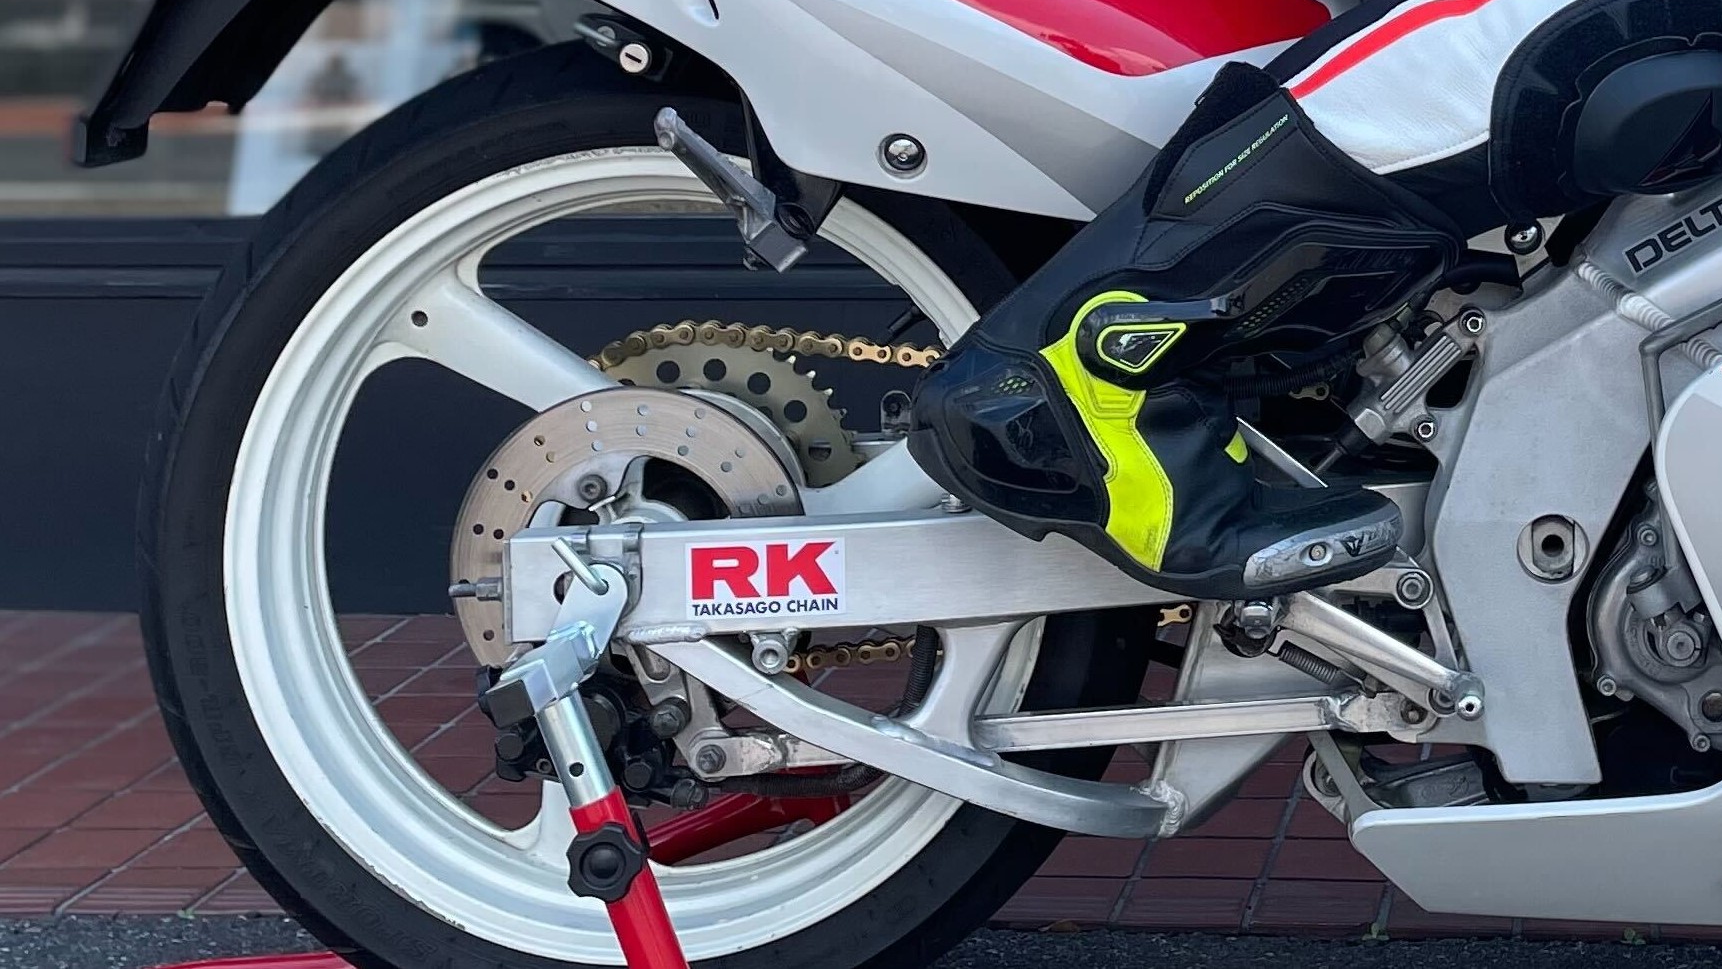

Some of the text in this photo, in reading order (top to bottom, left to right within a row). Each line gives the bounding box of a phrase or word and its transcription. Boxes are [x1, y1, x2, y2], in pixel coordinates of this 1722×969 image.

[691, 541, 839, 600] RK
[691, 597, 839, 617] TAKASAGO CHAIN
